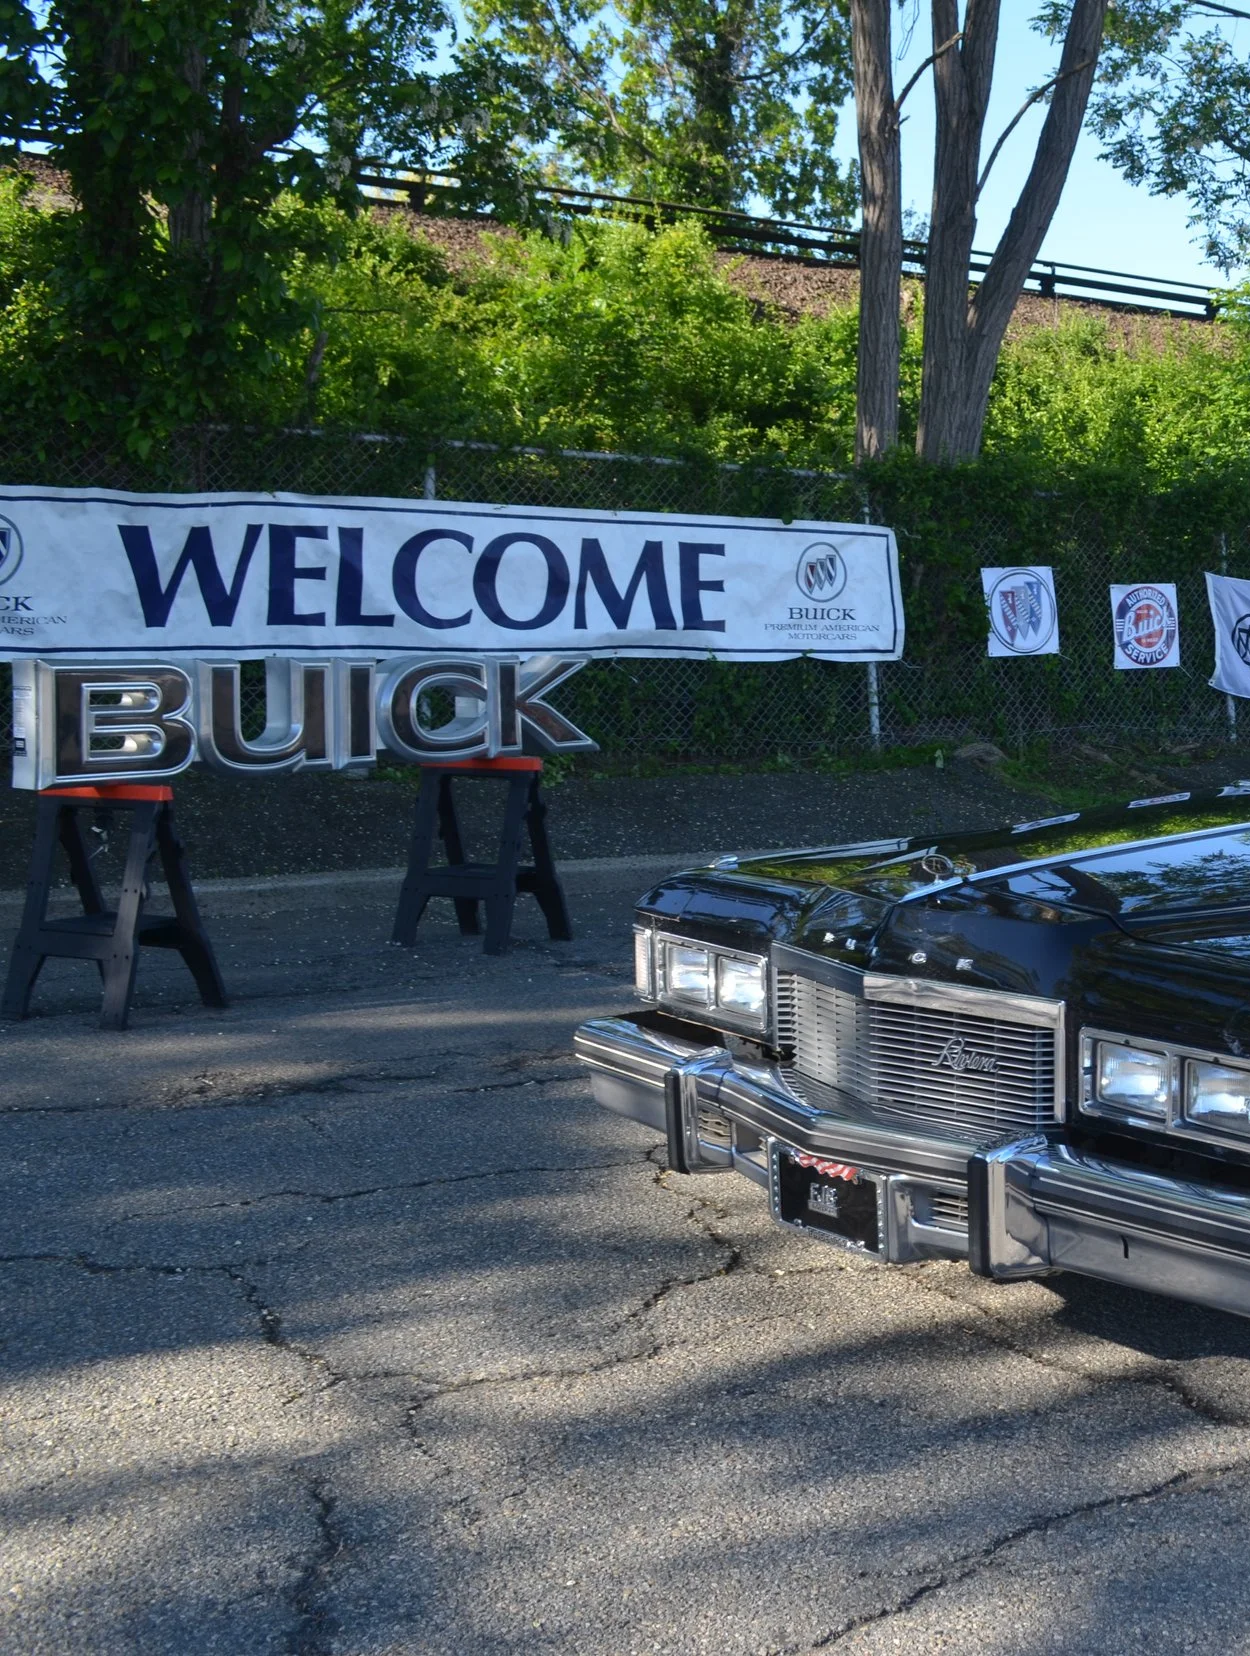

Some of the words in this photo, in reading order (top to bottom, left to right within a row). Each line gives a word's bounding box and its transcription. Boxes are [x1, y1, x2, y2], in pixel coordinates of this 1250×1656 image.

[118, 523, 726, 633] WELCOME
[0, 615, 68, 625] ERICAN
[787, 607, 857, 621] BUICK
[1122, 604, 1170, 642] Buick
[764, 623, 818, 632] PREMIUM
[821, 624, 881, 632] AMERICAN
[1124, 644, 1169, 663] SERVICE
[12, 655, 600, 790] BUICK
